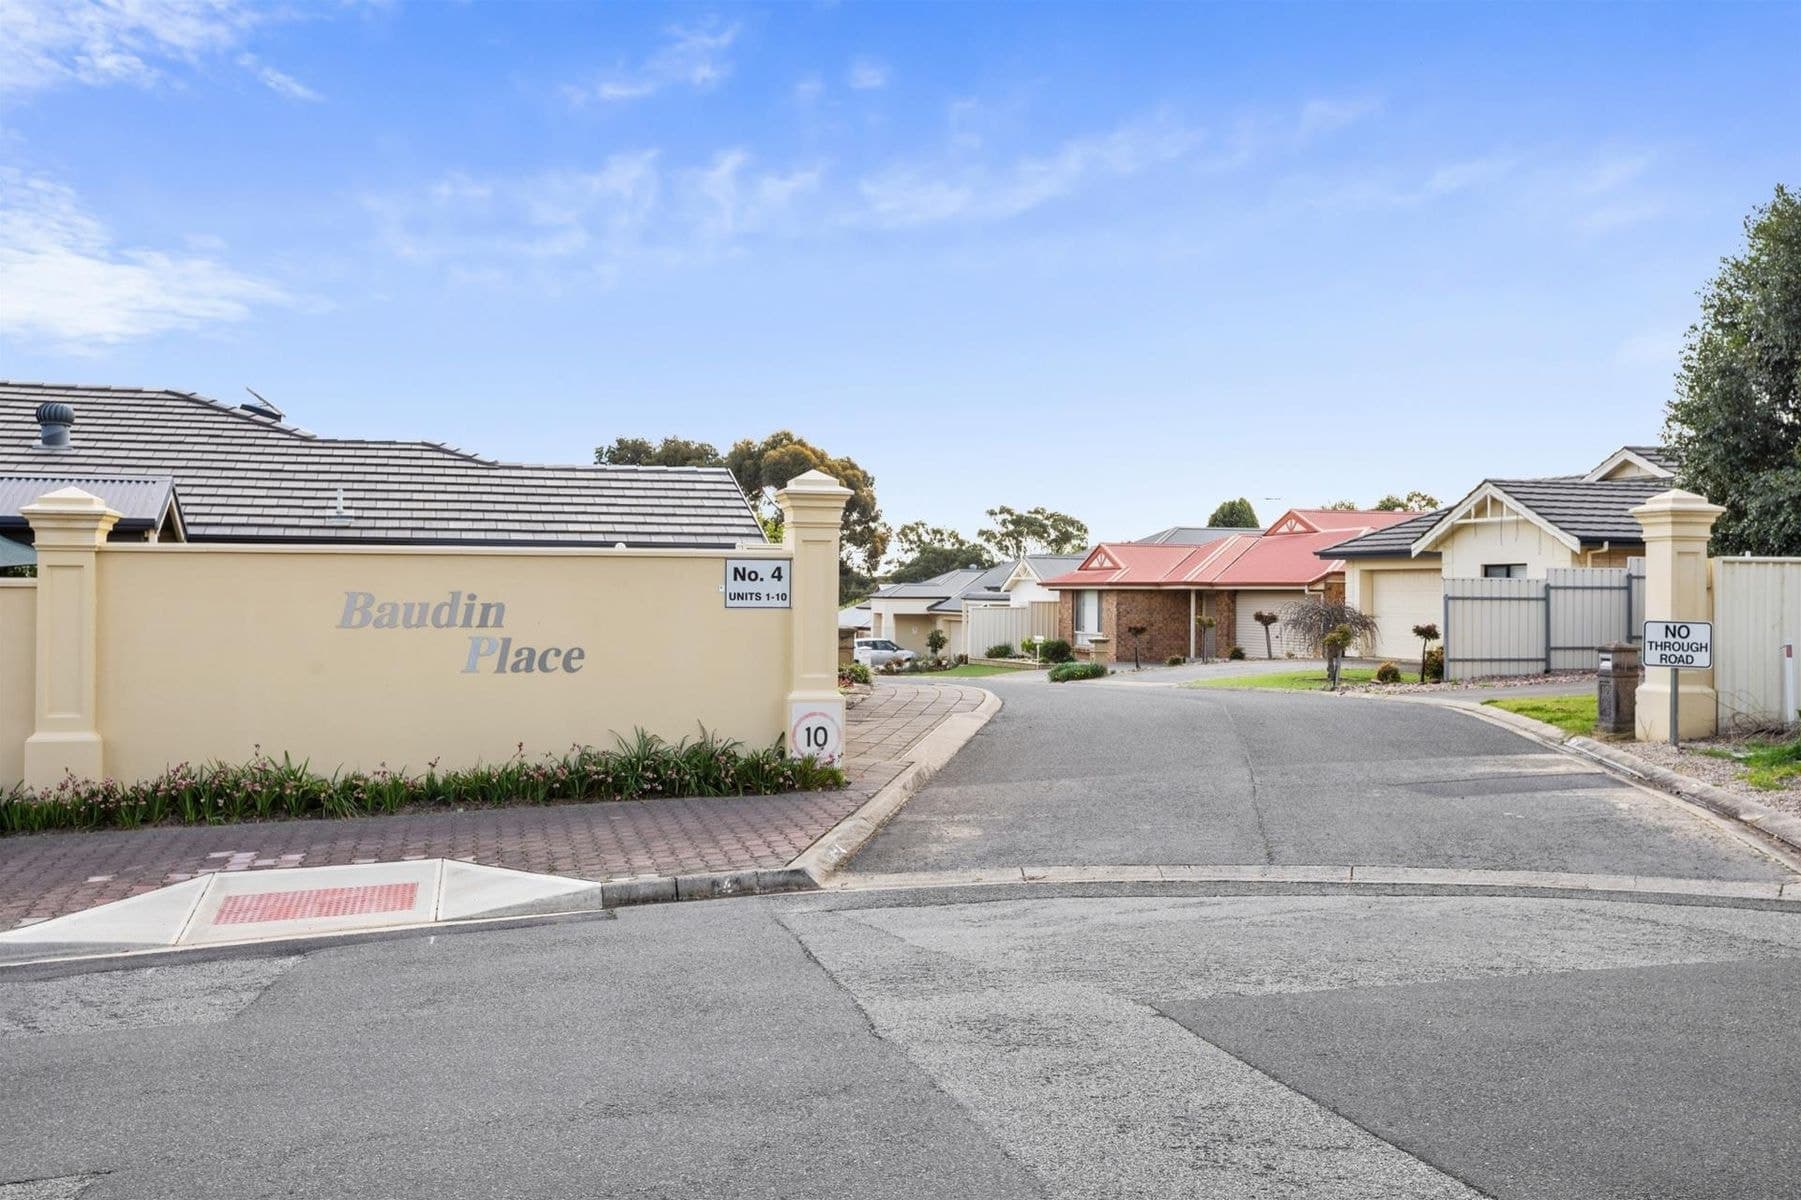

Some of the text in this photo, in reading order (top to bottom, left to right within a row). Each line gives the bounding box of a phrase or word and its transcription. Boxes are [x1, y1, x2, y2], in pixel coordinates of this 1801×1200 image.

[733, 566, 783, 581] No. 4
[729, 592, 788, 601] UNITS 1-10
[335, 590, 506, 629] Baudin
[1664, 624, 1690, 639] NO
[460, 635, 585, 674] Place
[1647, 641, 1709, 653] THROUGH
[1660, 653, 1695, 665] ROAD
[805, 726, 828, 748] 10
